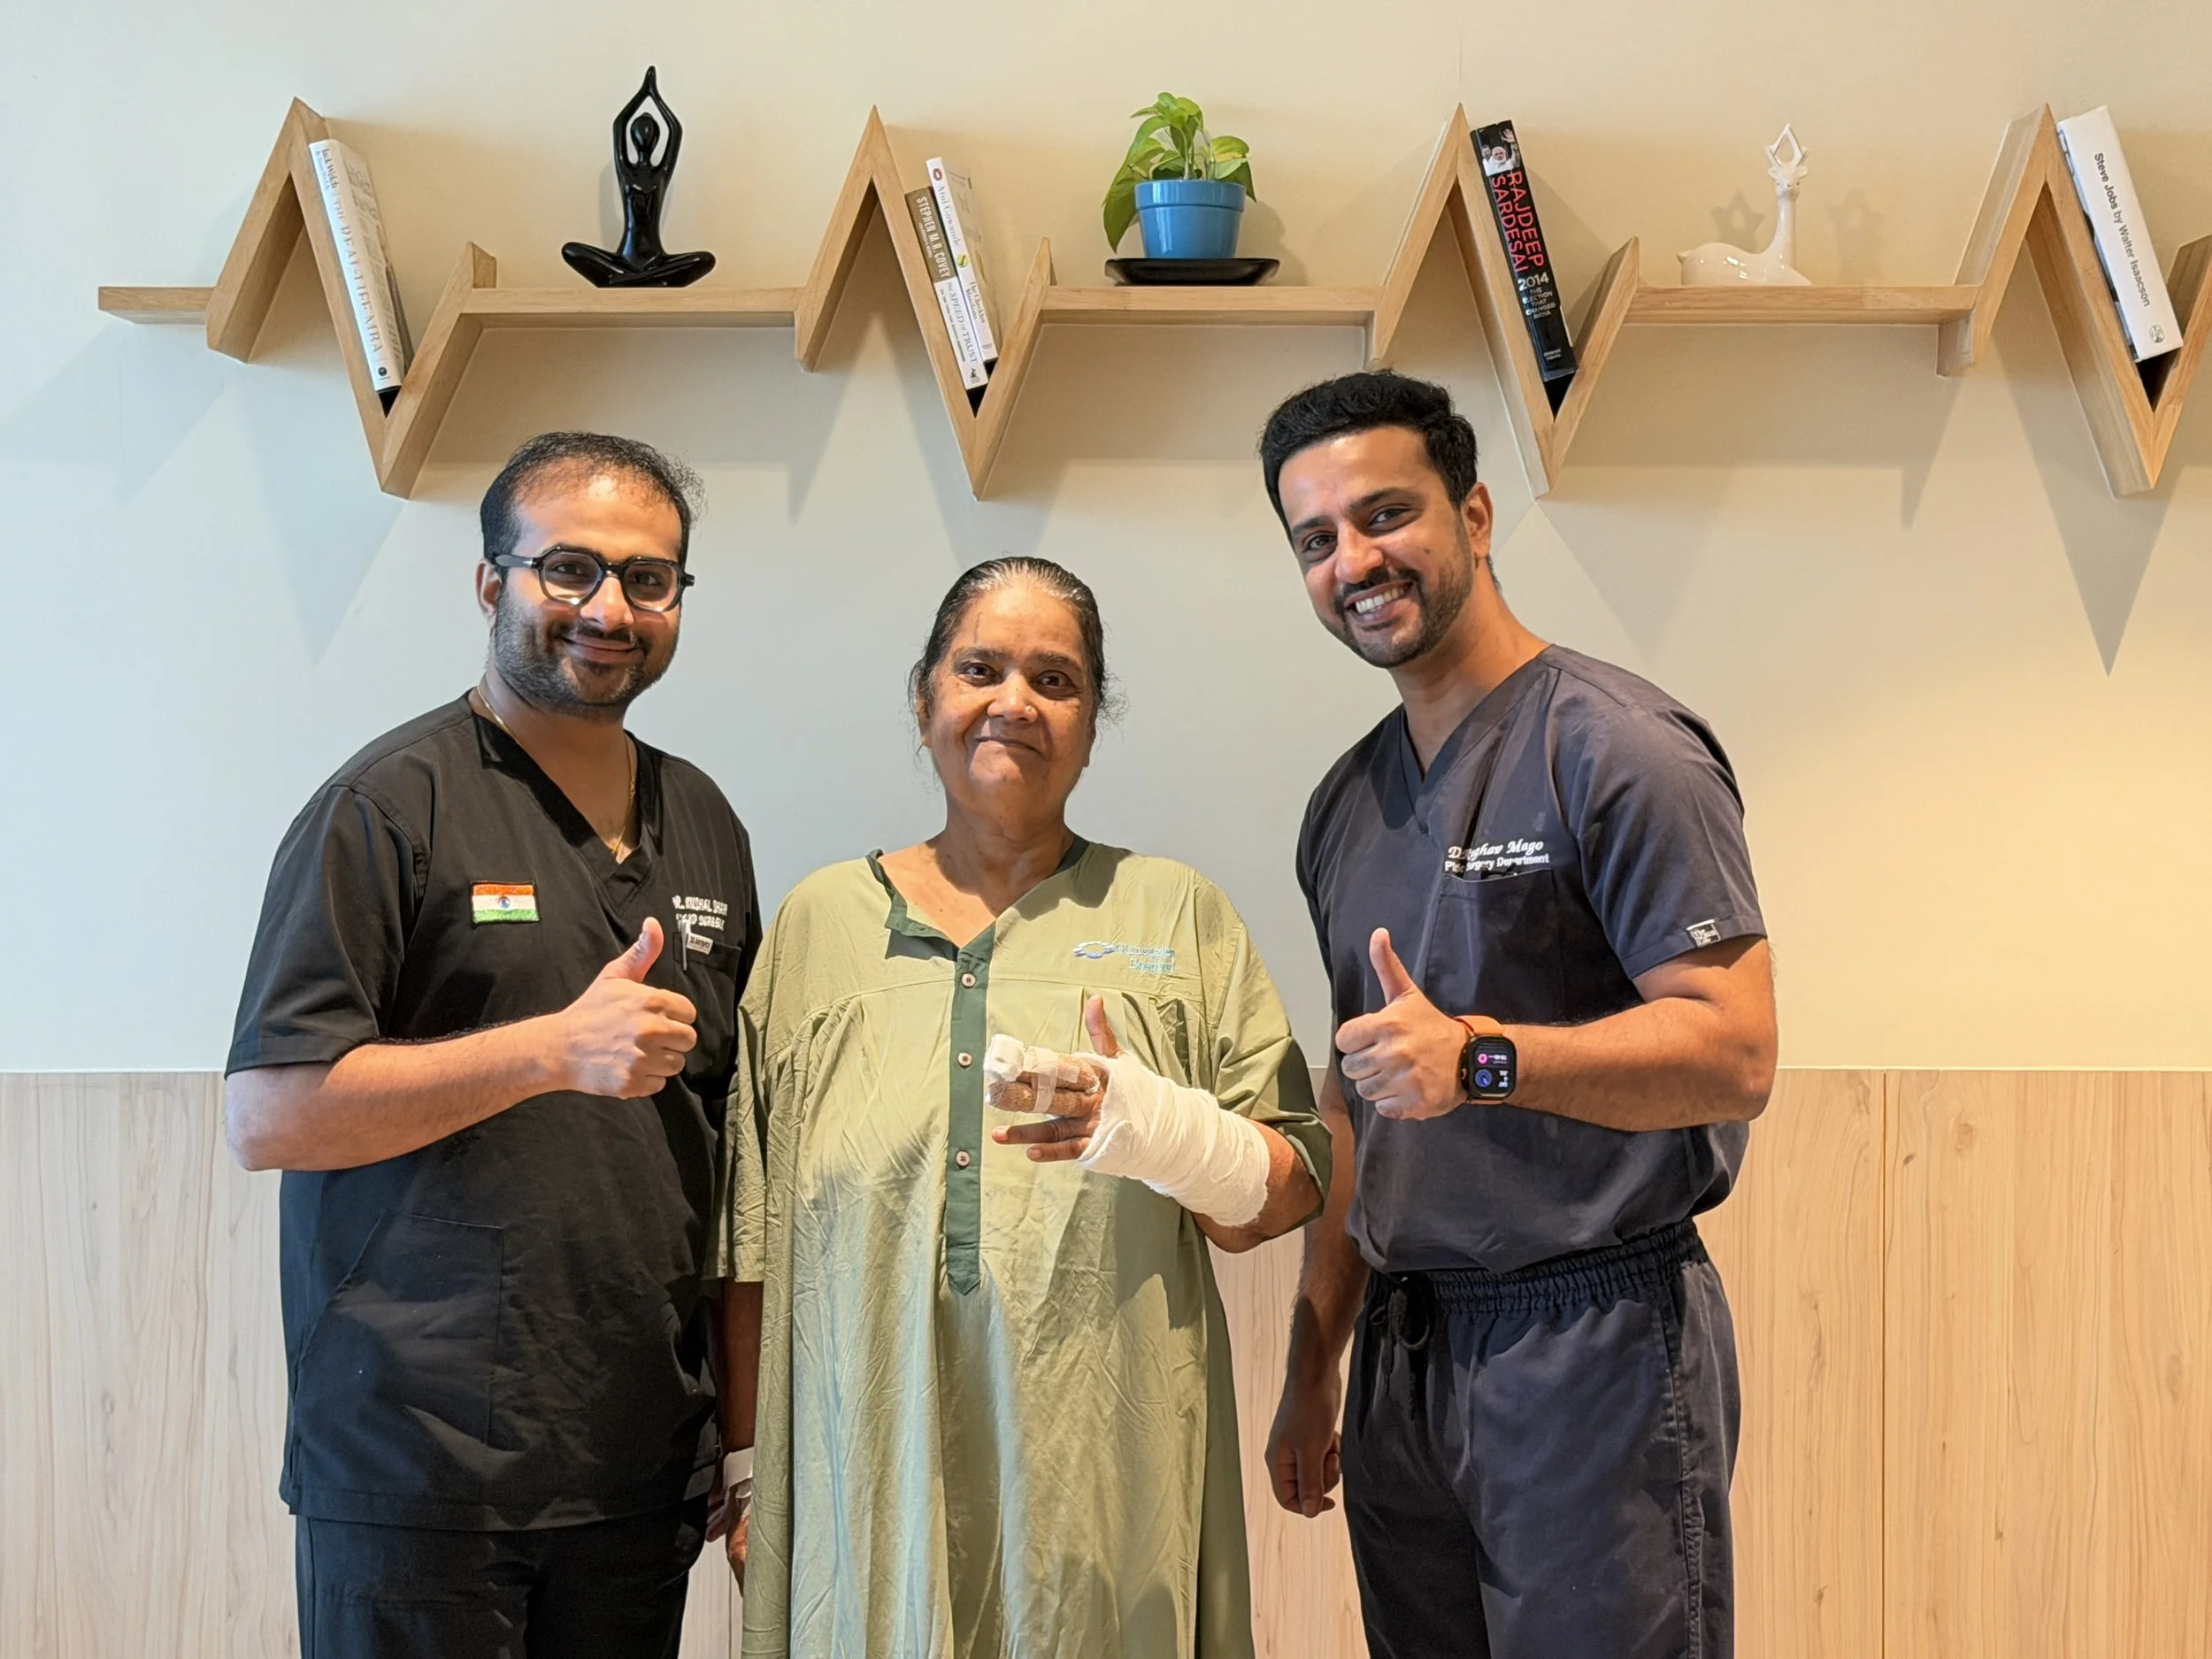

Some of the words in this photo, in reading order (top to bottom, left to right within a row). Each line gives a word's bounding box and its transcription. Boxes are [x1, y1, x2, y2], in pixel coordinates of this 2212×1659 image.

[2094, 152, 2108, 182] Steve
[2104, 184, 2118, 210] Jobs
[1491, 176, 1529, 273] SARDESAI
[1507, 170, 1545, 267] RAJDEEP
[2113, 211, 2124, 225] by
[915, 196, 937, 233] STEPHEN
[933, 251, 950, 278] COVEY
[2117, 225, 2135, 258] Walter
[1517, 273, 1549, 291] 2014
[2130, 259, 2150, 307] Isaacson
[949, 291, 964, 323] SPEED
[961, 330, 978, 365] TRUST
[1496, 853, 1550, 868] Department
[1506, 838, 1544, 856] Mago
